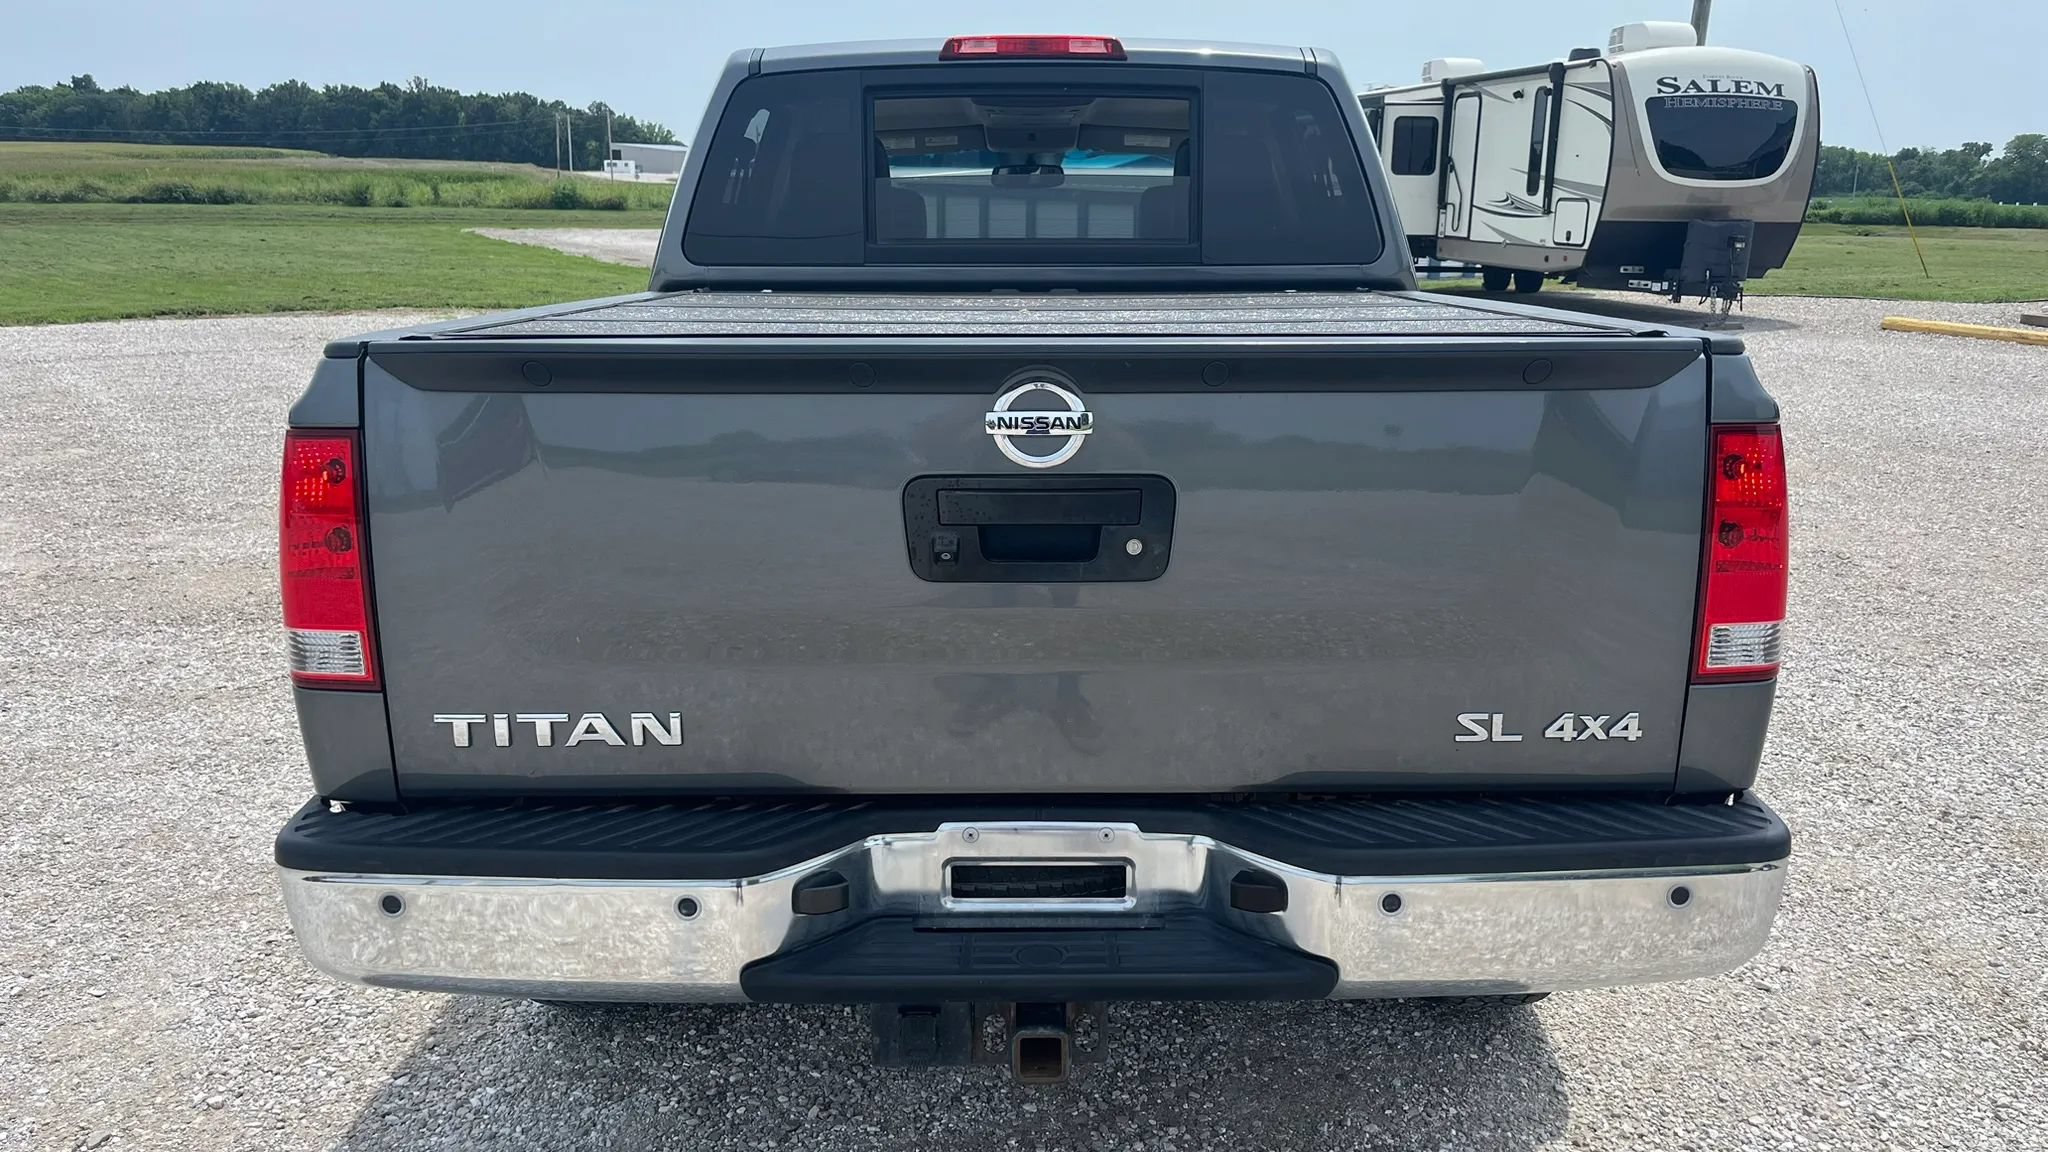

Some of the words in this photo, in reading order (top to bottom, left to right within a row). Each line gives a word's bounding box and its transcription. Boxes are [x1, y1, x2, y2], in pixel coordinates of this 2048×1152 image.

[1656, 76, 1785, 97] SALEM
[1664, 97, 1784, 111] HEMISPHERE
[997, 416, 1081, 430] NISSAN
[433, 712, 682, 747] TITAN
[1455, 713, 1523, 742] SL
